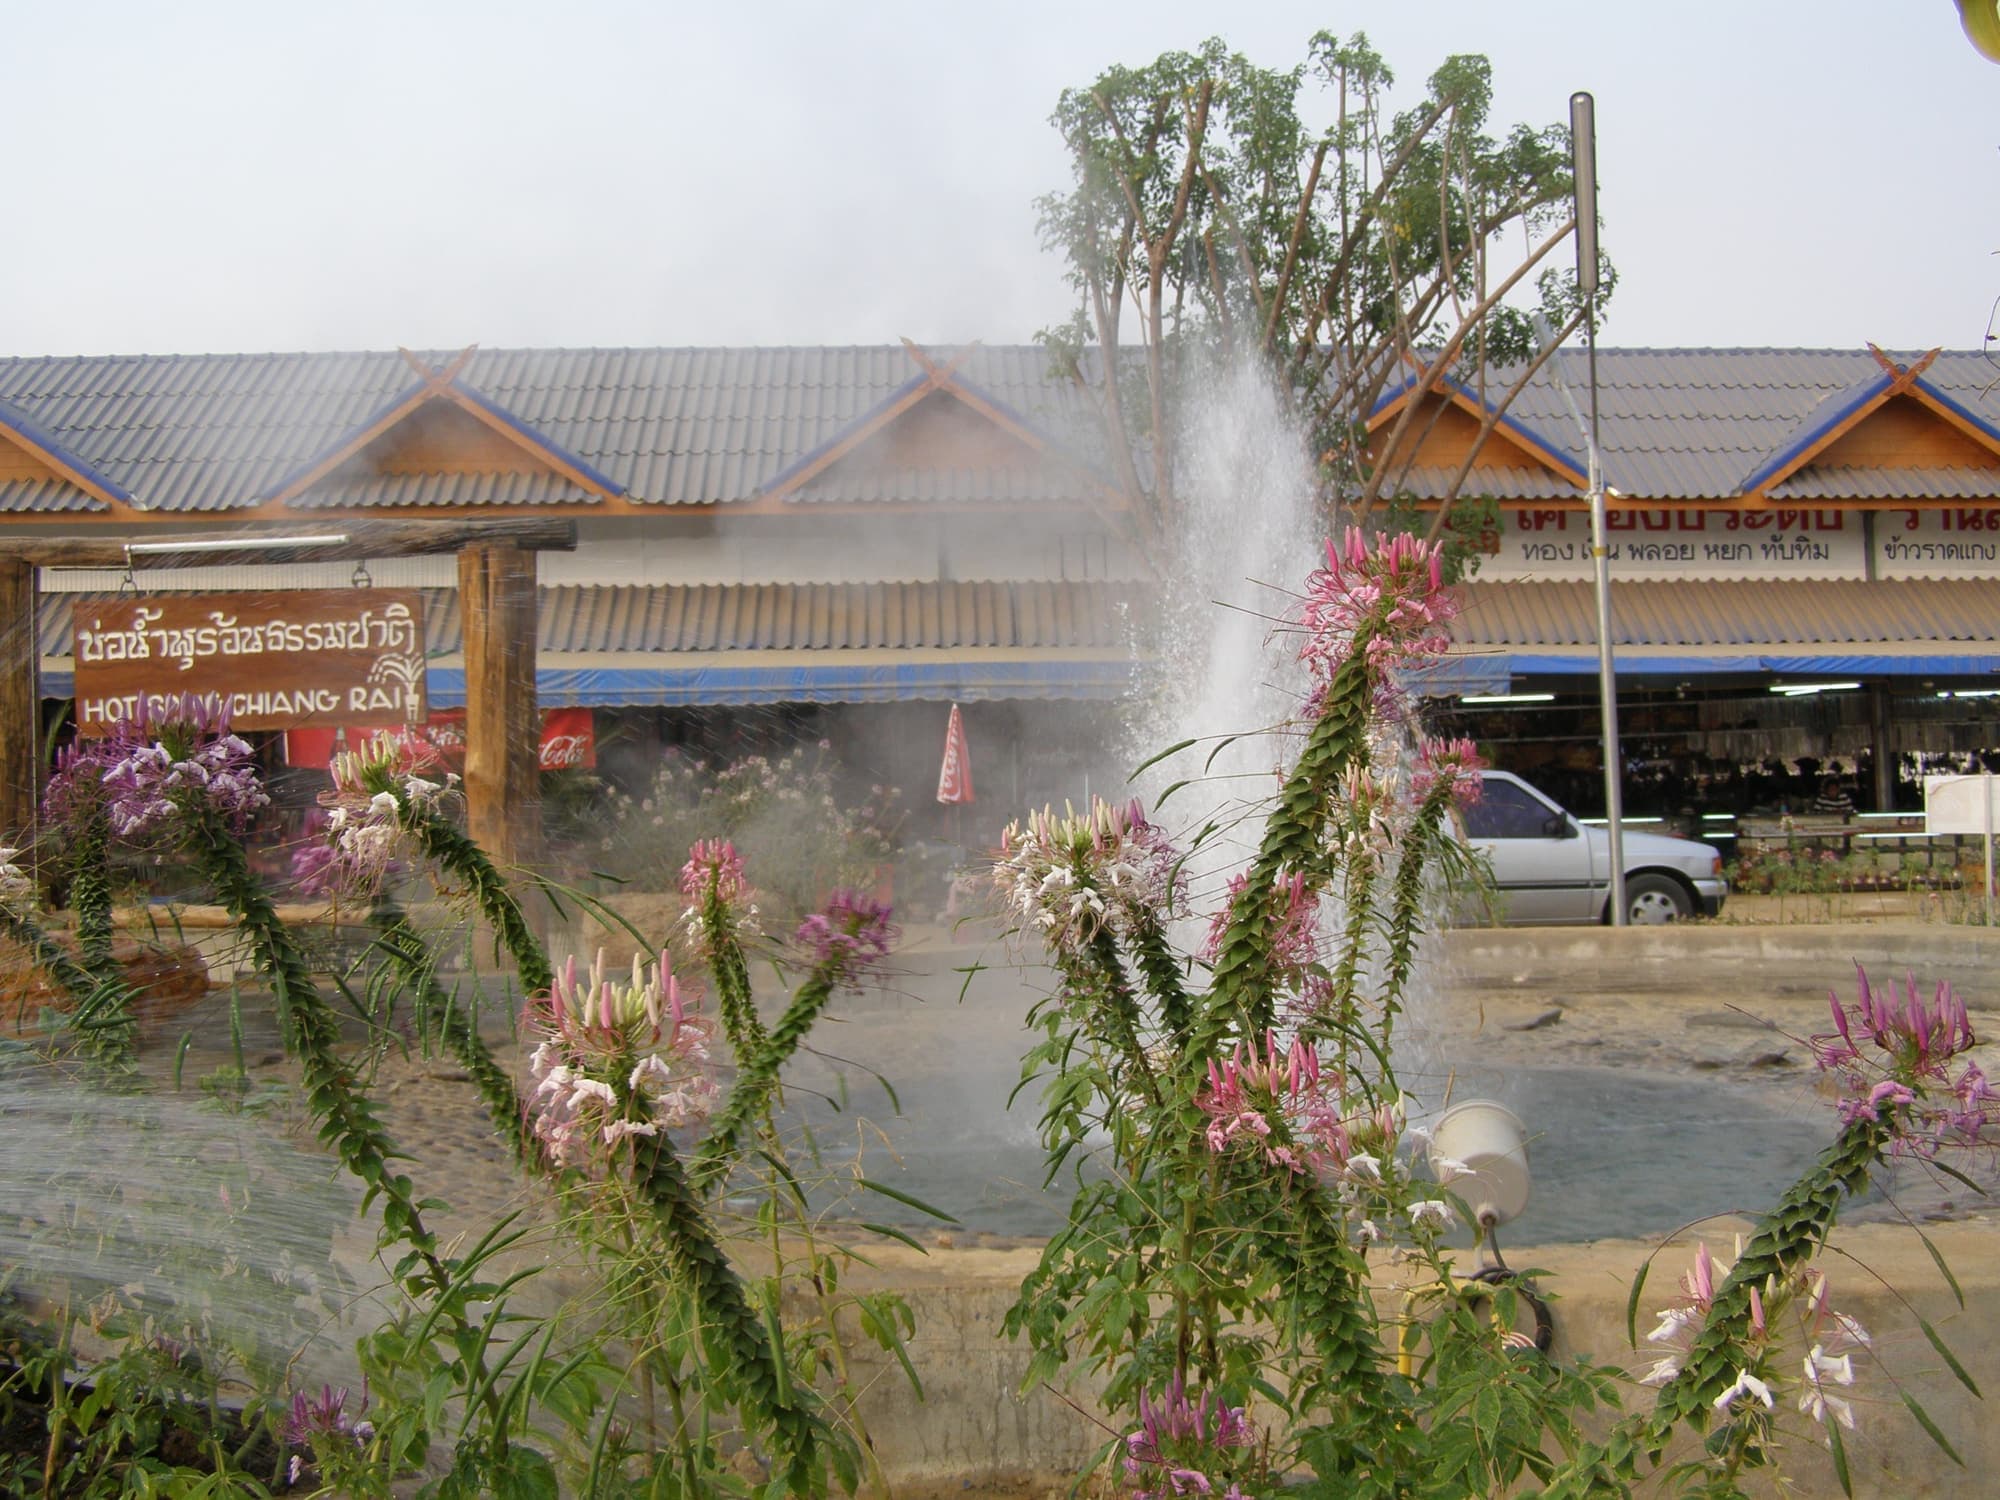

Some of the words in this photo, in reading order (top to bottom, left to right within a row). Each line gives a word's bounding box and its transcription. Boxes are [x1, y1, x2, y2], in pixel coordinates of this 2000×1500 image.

[1521, 543, 1574, 561] ทอง
[1582, 536, 1620, 560] เน
[1627, 543, 1695, 561] พลอย
[1703, 543, 1752, 561] หยก
[1760, 534, 1829, 561] ทับทิม
[1884, 535, 1996, 561] ข้าวราดแกง
[78, 603, 415, 671] บ่อน้ำพุร้อนธรรมชาติ
[84, 697, 137, 723] HOT
[232, 689, 341, 717] CHIANG
[349, 686, 399, 712] RAI
